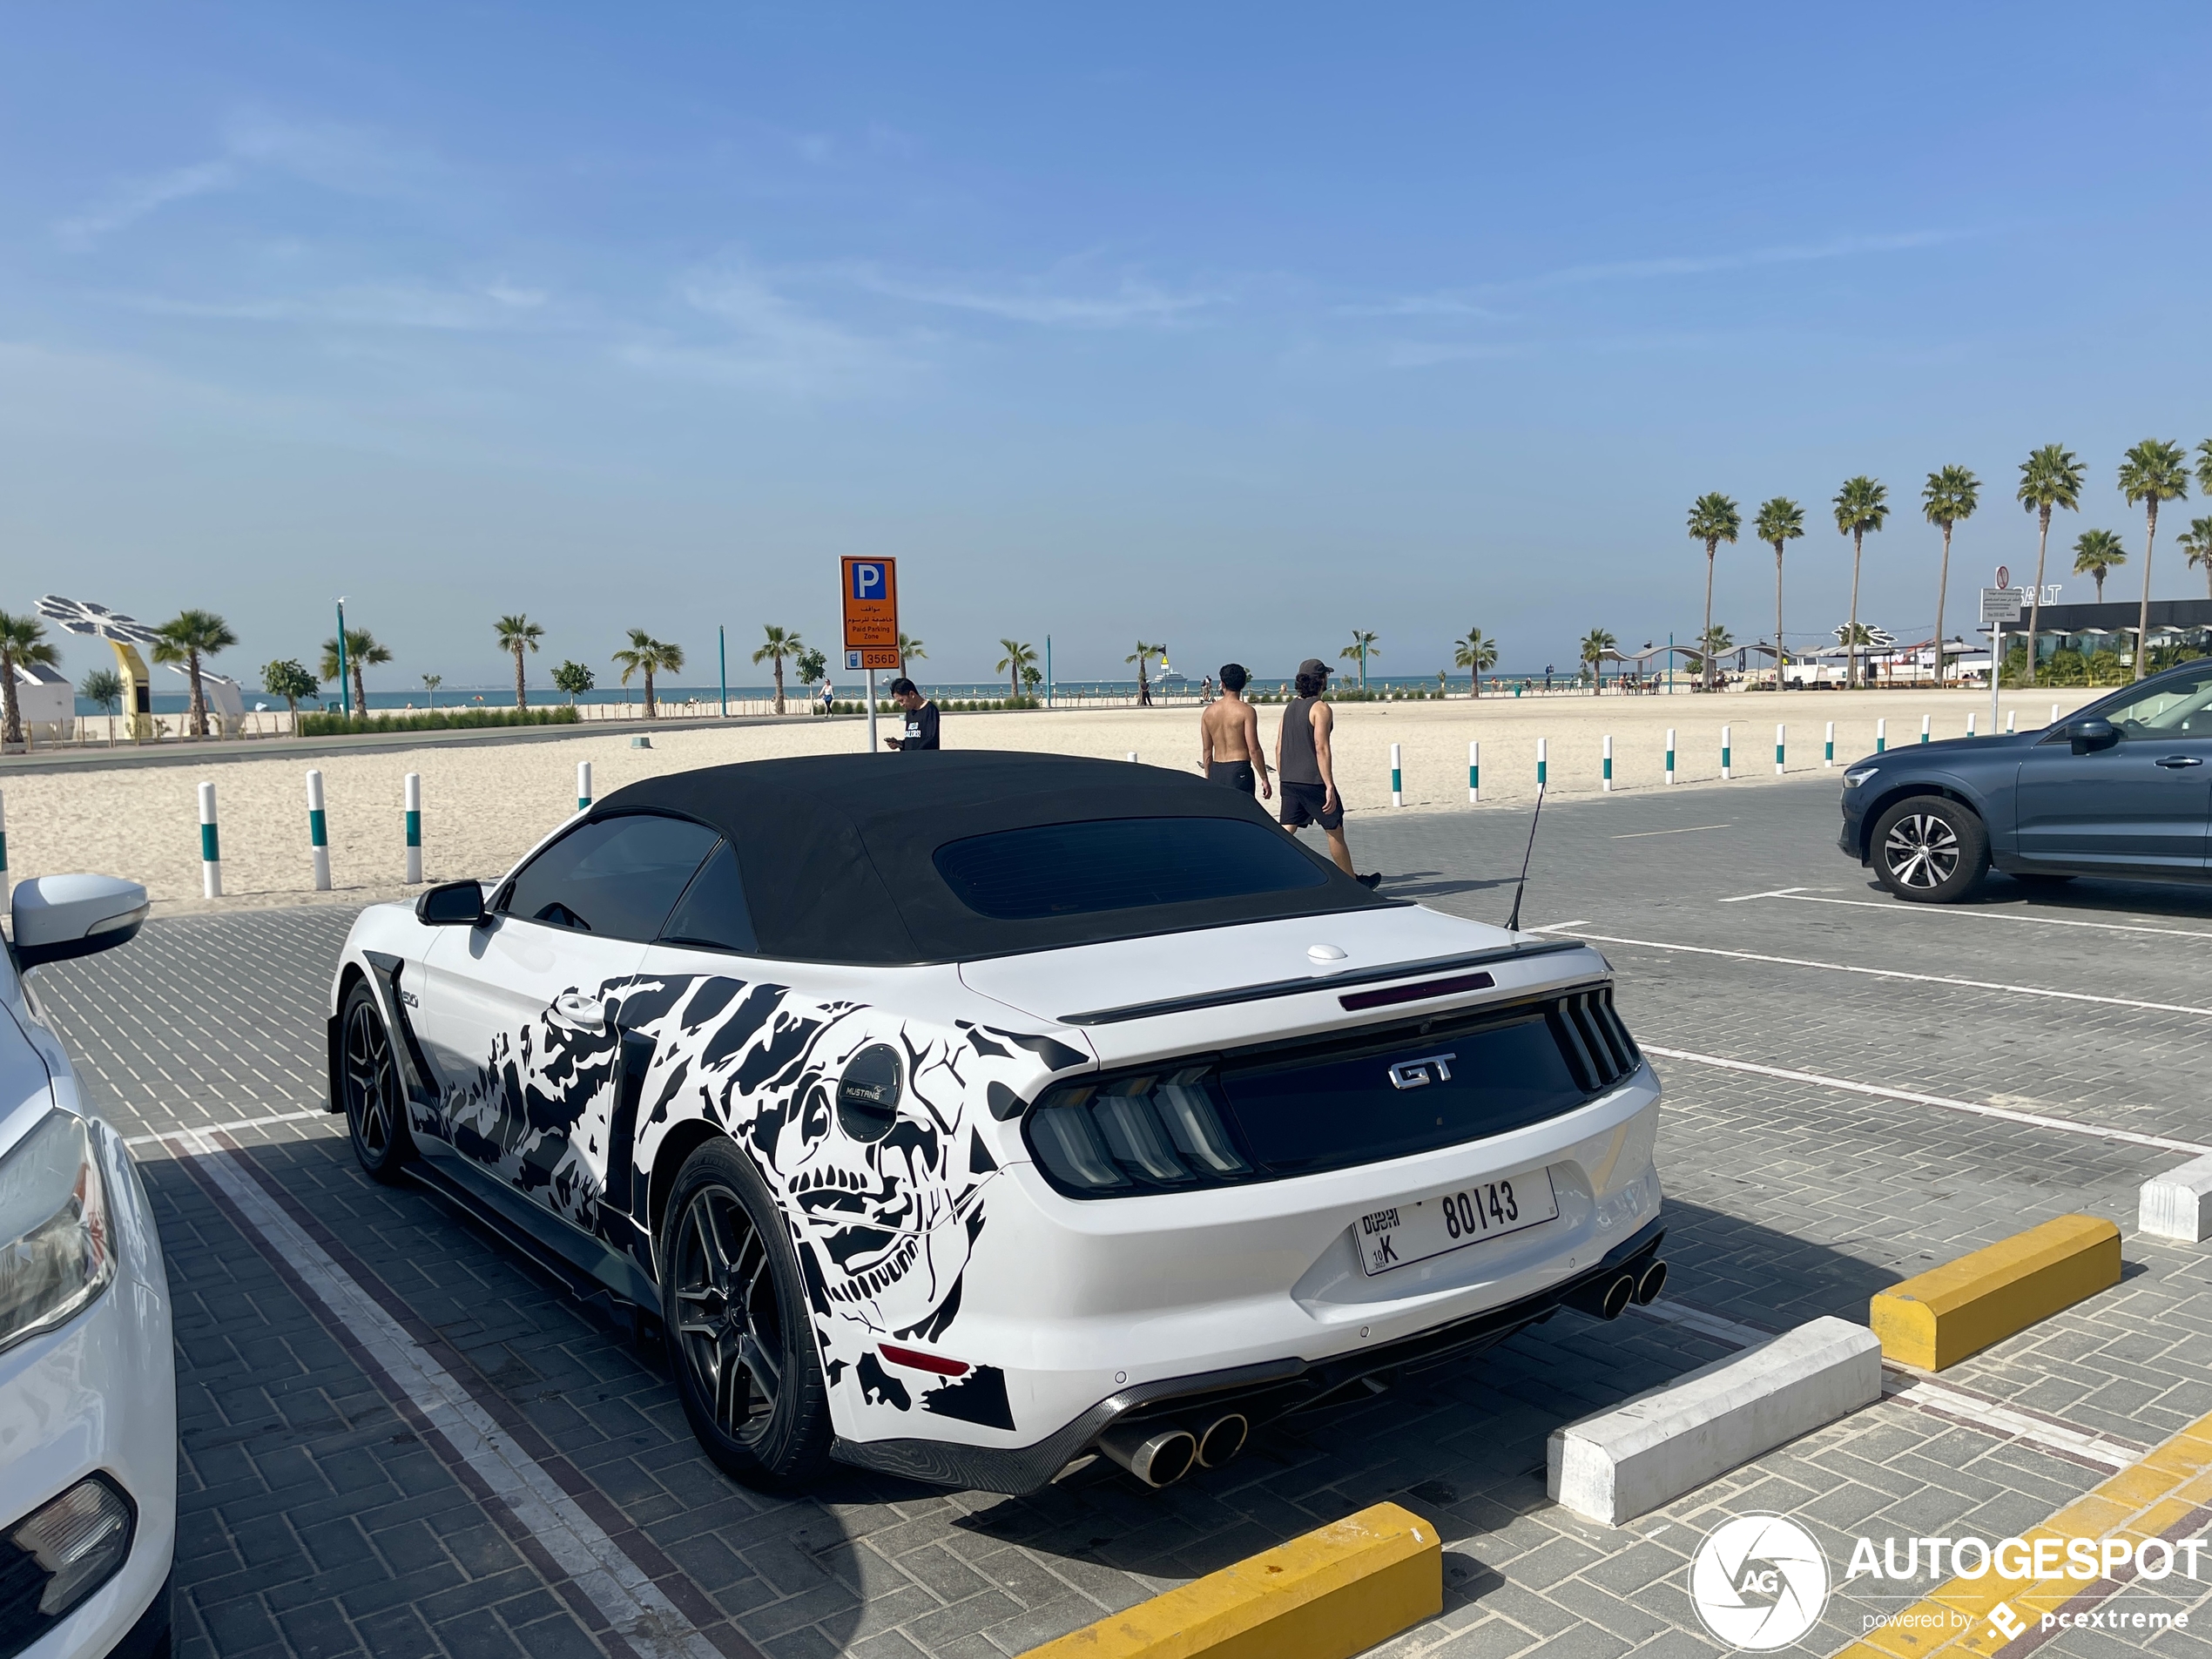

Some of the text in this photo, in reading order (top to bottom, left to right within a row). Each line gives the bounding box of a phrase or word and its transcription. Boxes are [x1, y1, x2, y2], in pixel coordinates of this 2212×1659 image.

[858, 564, 880, 598] P
[867, 654, 896, 664] 356D
[1387, 1052, 1457, 1090] GT
[846, 1087, 880, 1100] MUSTANG
[1442, 1181, 1519, 1239] 80143
[1373, 1235, 1399, 1264] 10 K
